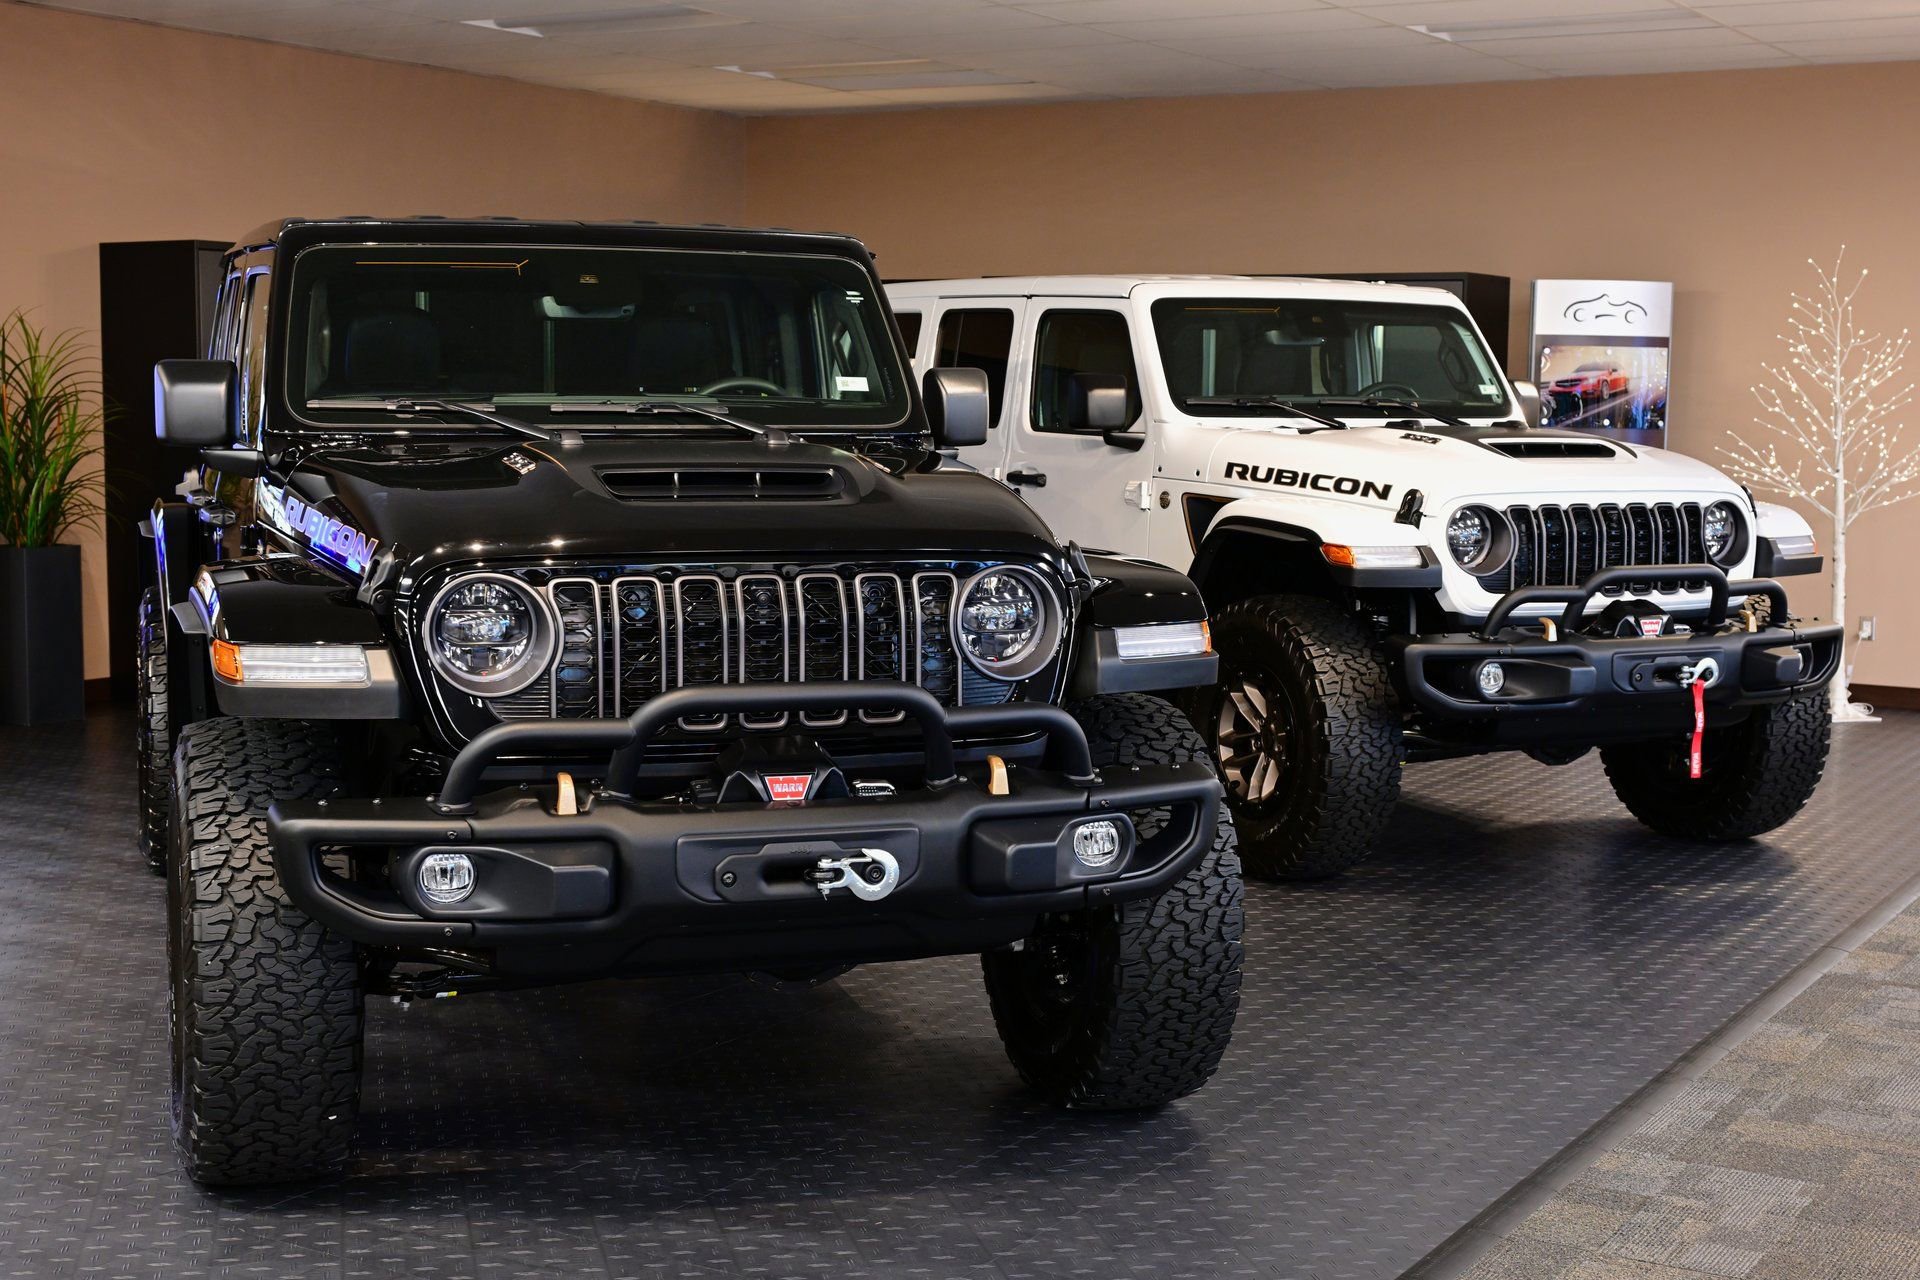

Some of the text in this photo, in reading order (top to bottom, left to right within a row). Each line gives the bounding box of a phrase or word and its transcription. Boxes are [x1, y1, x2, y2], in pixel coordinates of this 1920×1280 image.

[1224, 461, 1393, 501] RUBICON
[284, 495, 379, 568] RUBICON
[1692, 752, 1700, 774] WARN
[772, 783, 803, 794] WARN
